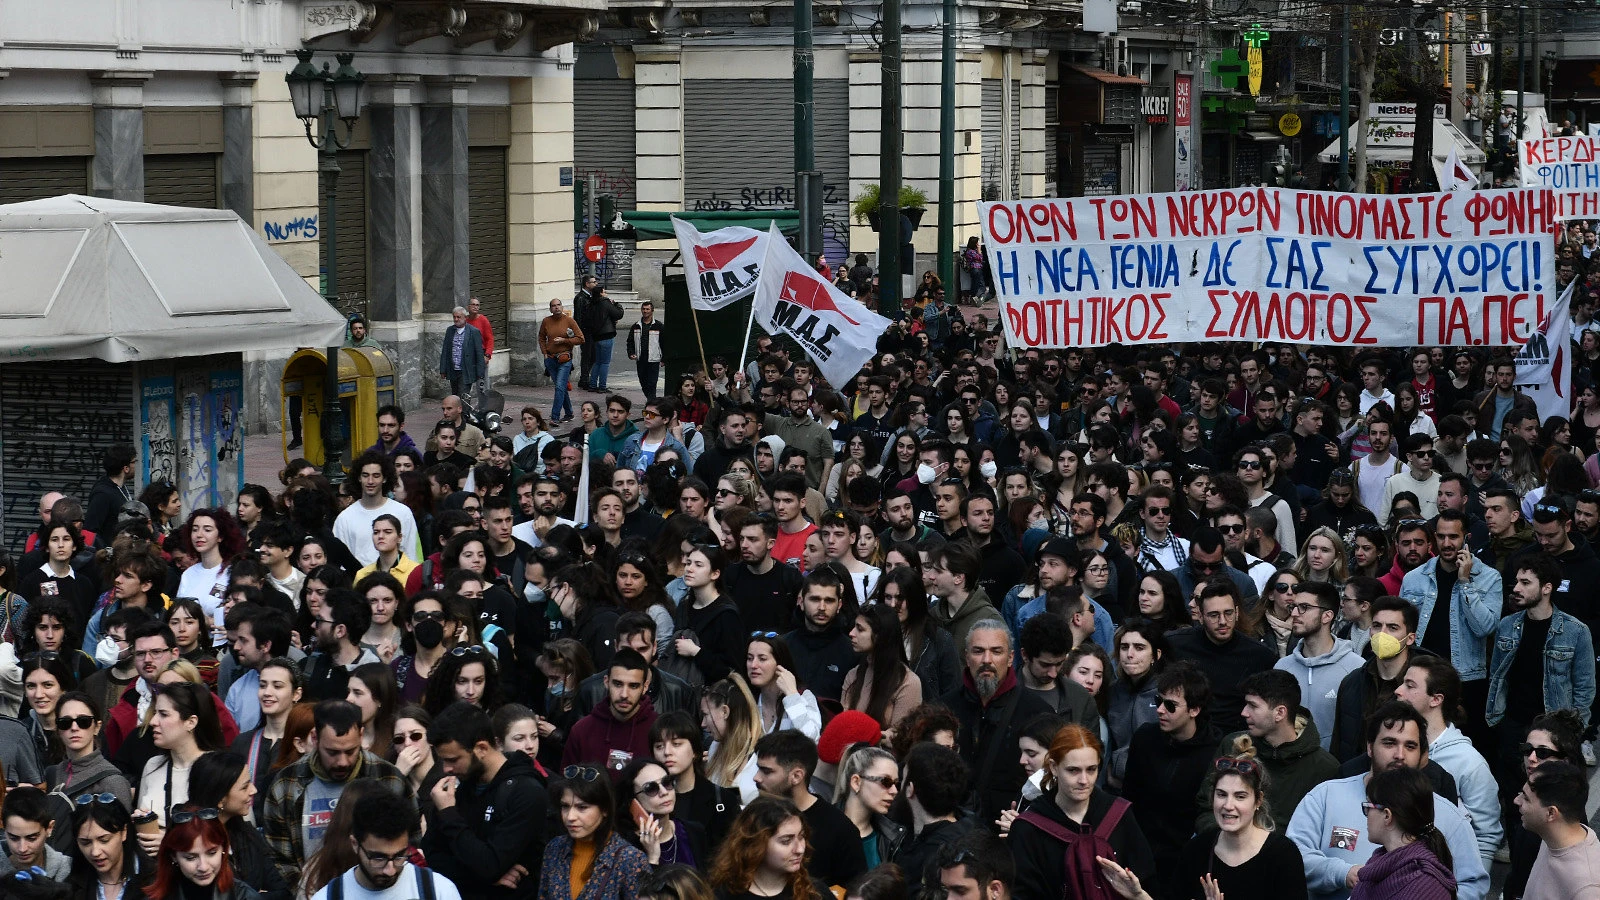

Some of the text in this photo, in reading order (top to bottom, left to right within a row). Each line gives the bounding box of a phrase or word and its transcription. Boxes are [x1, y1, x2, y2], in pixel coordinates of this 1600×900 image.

[1177, 82, 1189, 96] SALE
[1378, 105, 1416, 115] NetBe
[1374, 159, 1411, 169] NetBe
[1537, 163, 1599, 188] ΦΟΙΤΗ
[988, 188, 1553, 244] ΟΛΩΝ ΤΩΝ ΝΕΚΡΩΝ ΓΙΝΟΜΑΣΤΕ ΦΩΝΗ!
[996, 237, 1543, 295] Η ΝΕΑ ΓΕΝΙΑ ΔΕ ΣΑΣ ΣΥΓΧΩΡΕΙ!
[1205, 289, 1377, 344] ΣΥΛΛΟΓΟΣ
